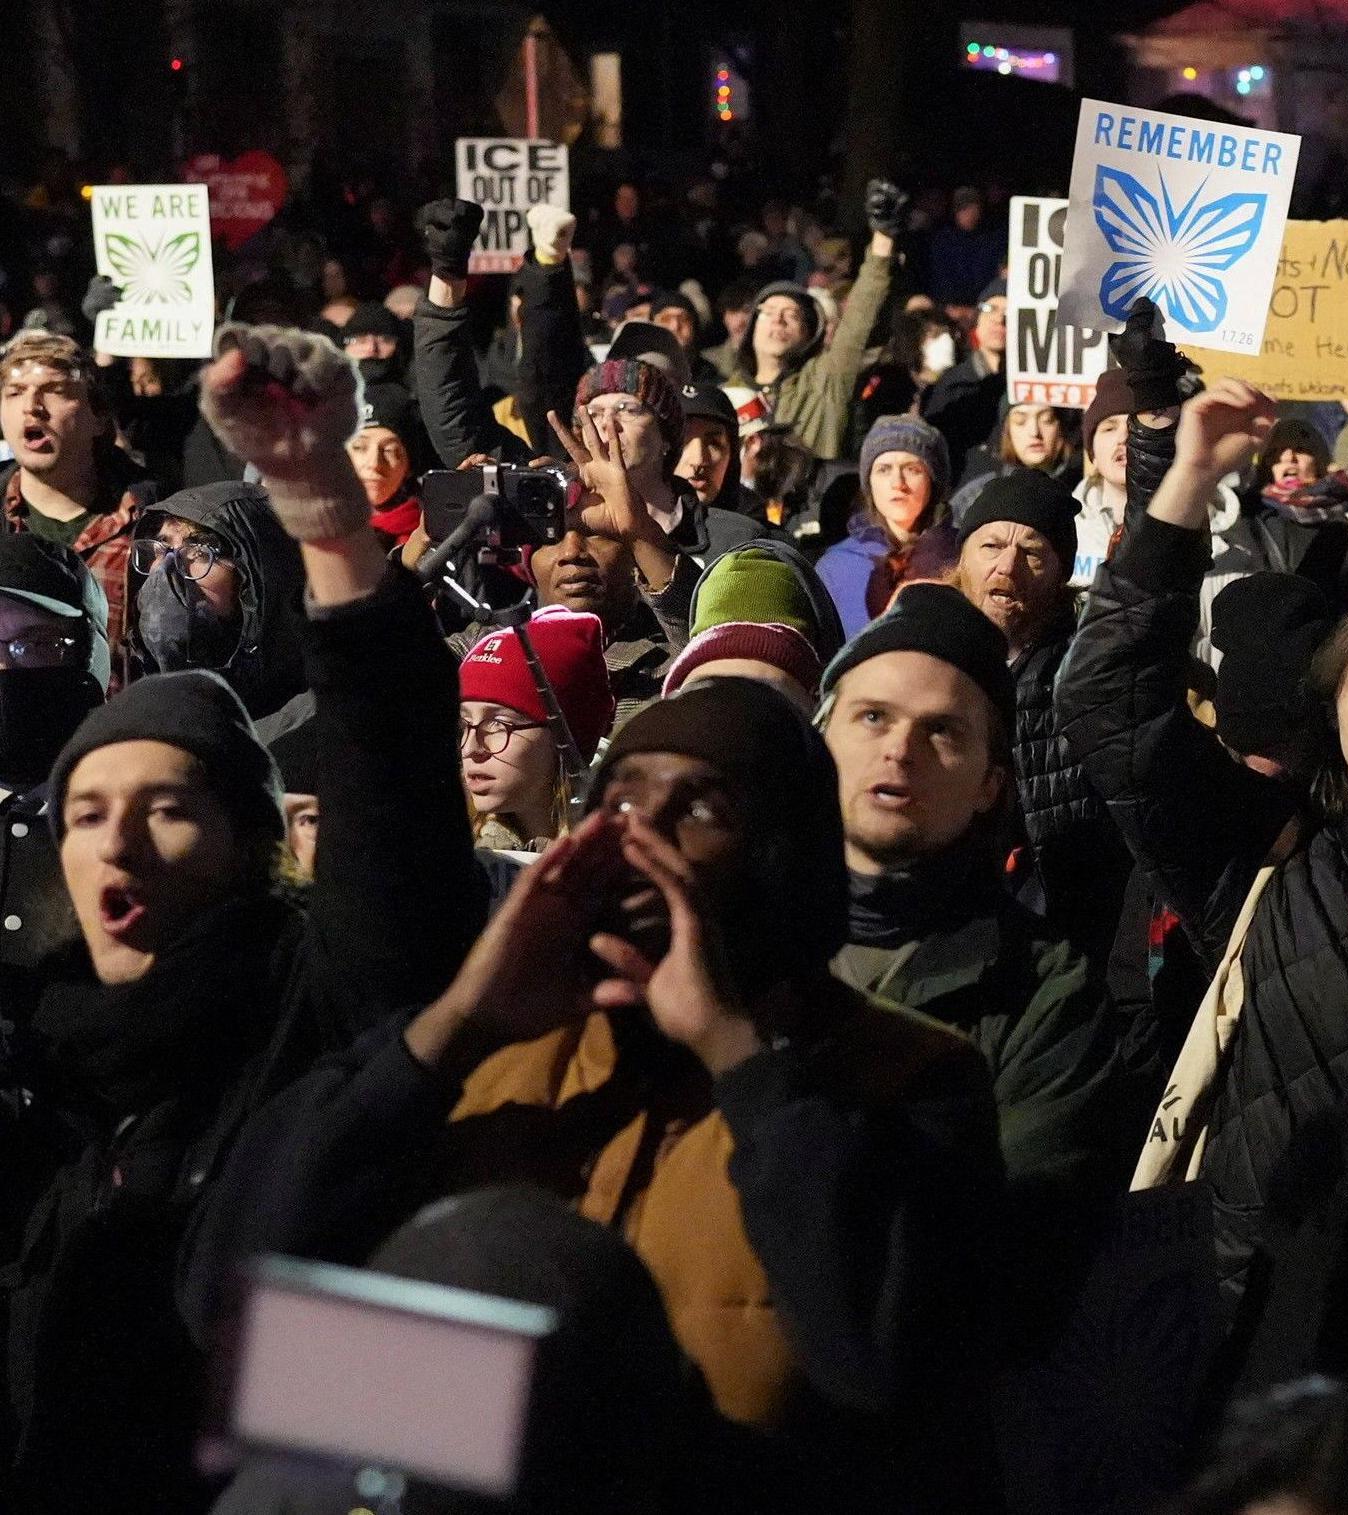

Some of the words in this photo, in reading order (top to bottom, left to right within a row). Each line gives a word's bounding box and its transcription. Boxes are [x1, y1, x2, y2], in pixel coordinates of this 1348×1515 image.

[1094, 112, 1282, 175] REMEMBER
[466, 144, 562, 171] ICE
[473, 176, 515, 204] OUT
[528, 176, 555, 204] OF
[101, 195, 137, 219] WE
[152, 194, 202, 218] ARE
[1270, 285, 1331, 324] OT
[104, 317, 203, 342] FAMILY
[1265, 337, 1296, 358] me
